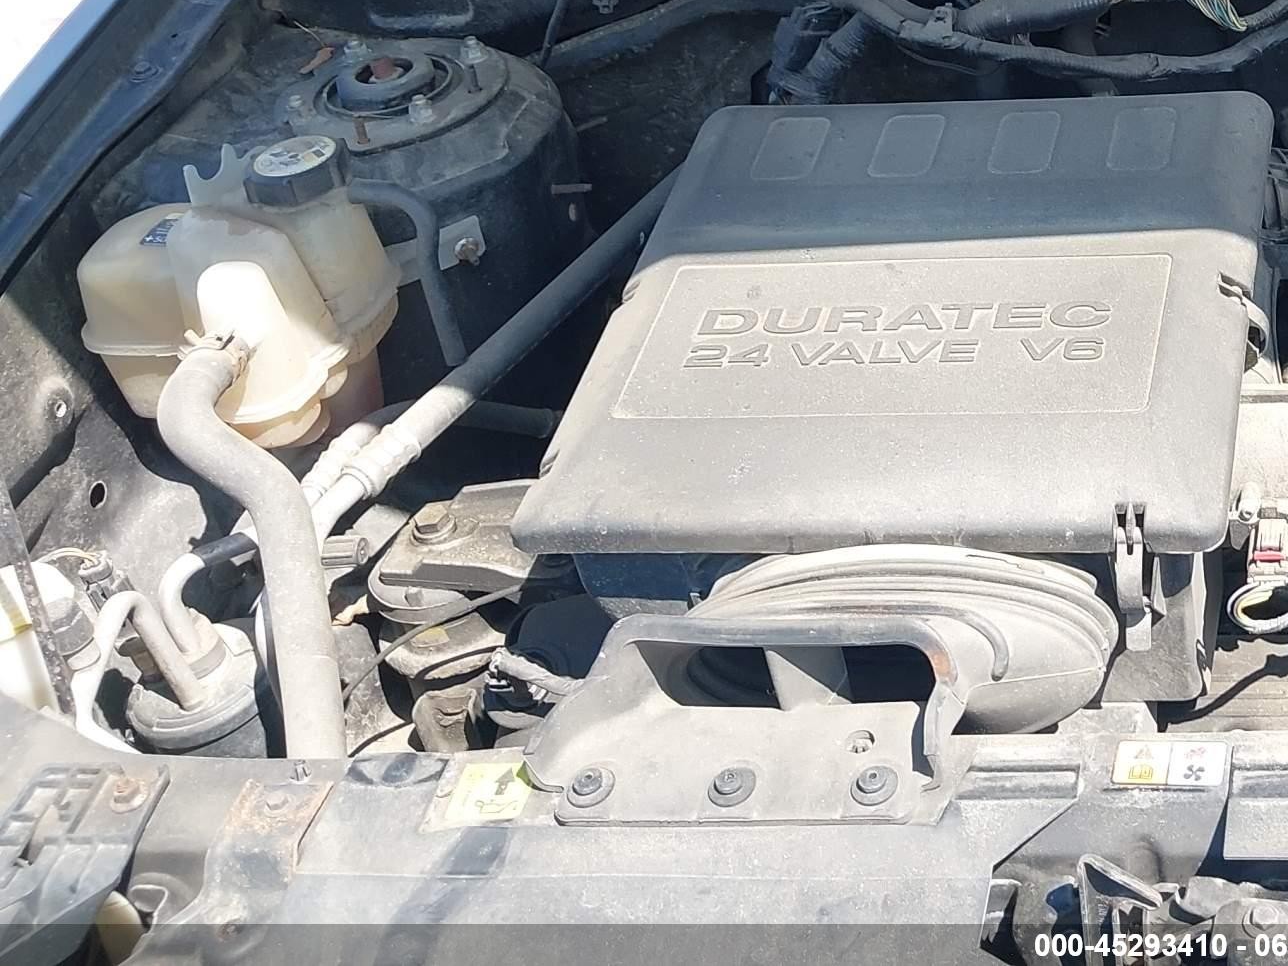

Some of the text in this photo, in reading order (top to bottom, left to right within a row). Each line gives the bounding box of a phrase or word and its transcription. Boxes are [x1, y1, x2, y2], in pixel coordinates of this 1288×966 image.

[696, 300, 1112, 336] DURATEC
[684, 336, 1105, 368] 24 VALVE V6
